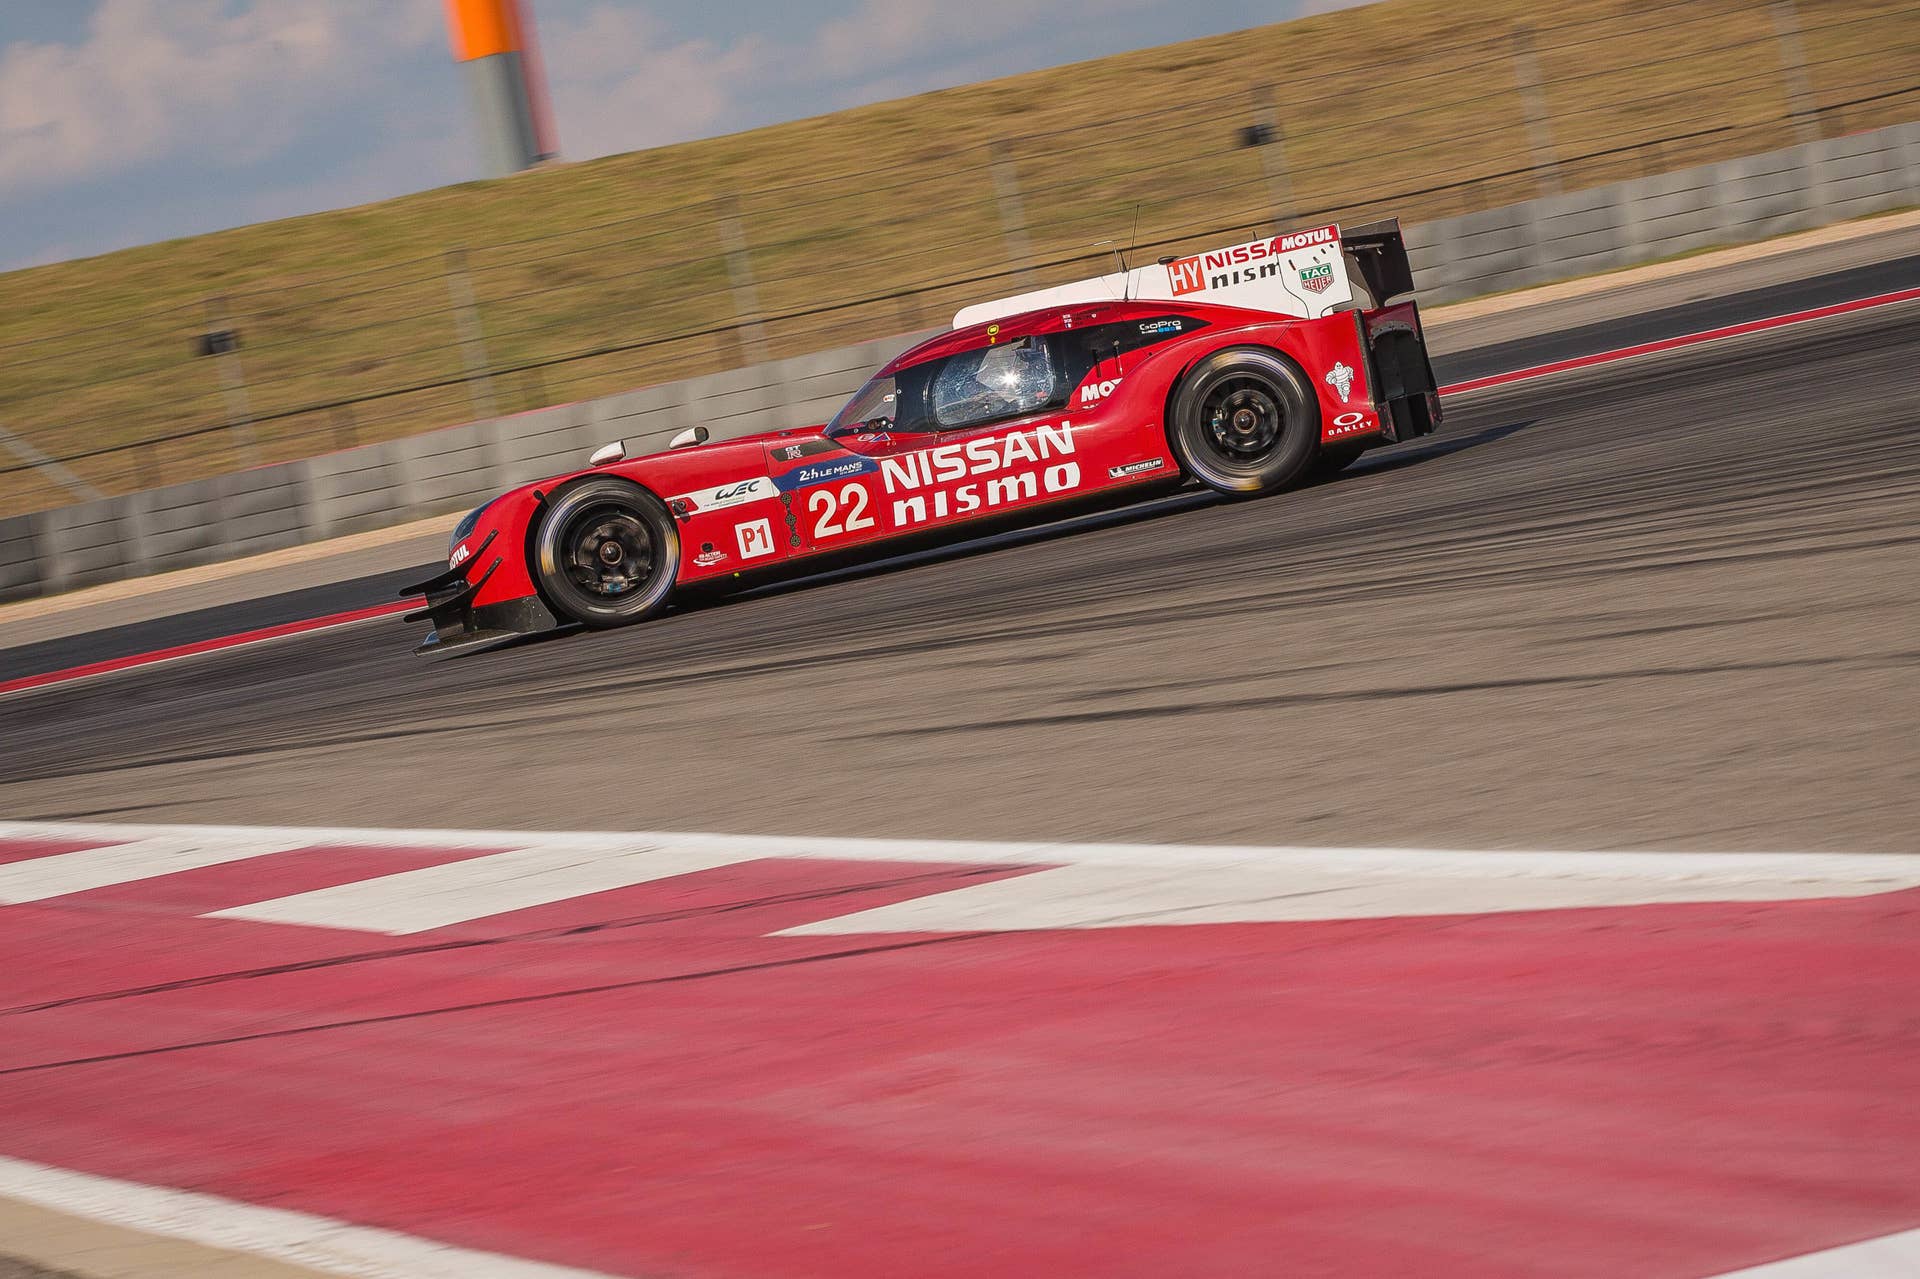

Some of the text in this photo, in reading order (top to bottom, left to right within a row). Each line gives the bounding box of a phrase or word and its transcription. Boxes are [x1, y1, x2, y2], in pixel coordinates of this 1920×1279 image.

[1281, 228, 1333, 250] MOTUL
[1168, 260, 1200, 292] HY
[1301, 266, 1331, 280] TAG
[1302, 276, 1334, 292] HEUER
[1139, 320, 1181, 331] GoPro
[1328, 420, 1372, 436] OAKLEY
[881, 420, 1076, 494] NISSAN
[1125, 459, 1162, 472] MICHELIN
[820, 468, 833, 477] LE
[833, 461, 863, 475] MANS
[715, 480, 760, 500] WEC
[892, 461, 1081, 527] nismo
[808, 483, 875, 539] 22
[741, 524, 769, 553] P1
